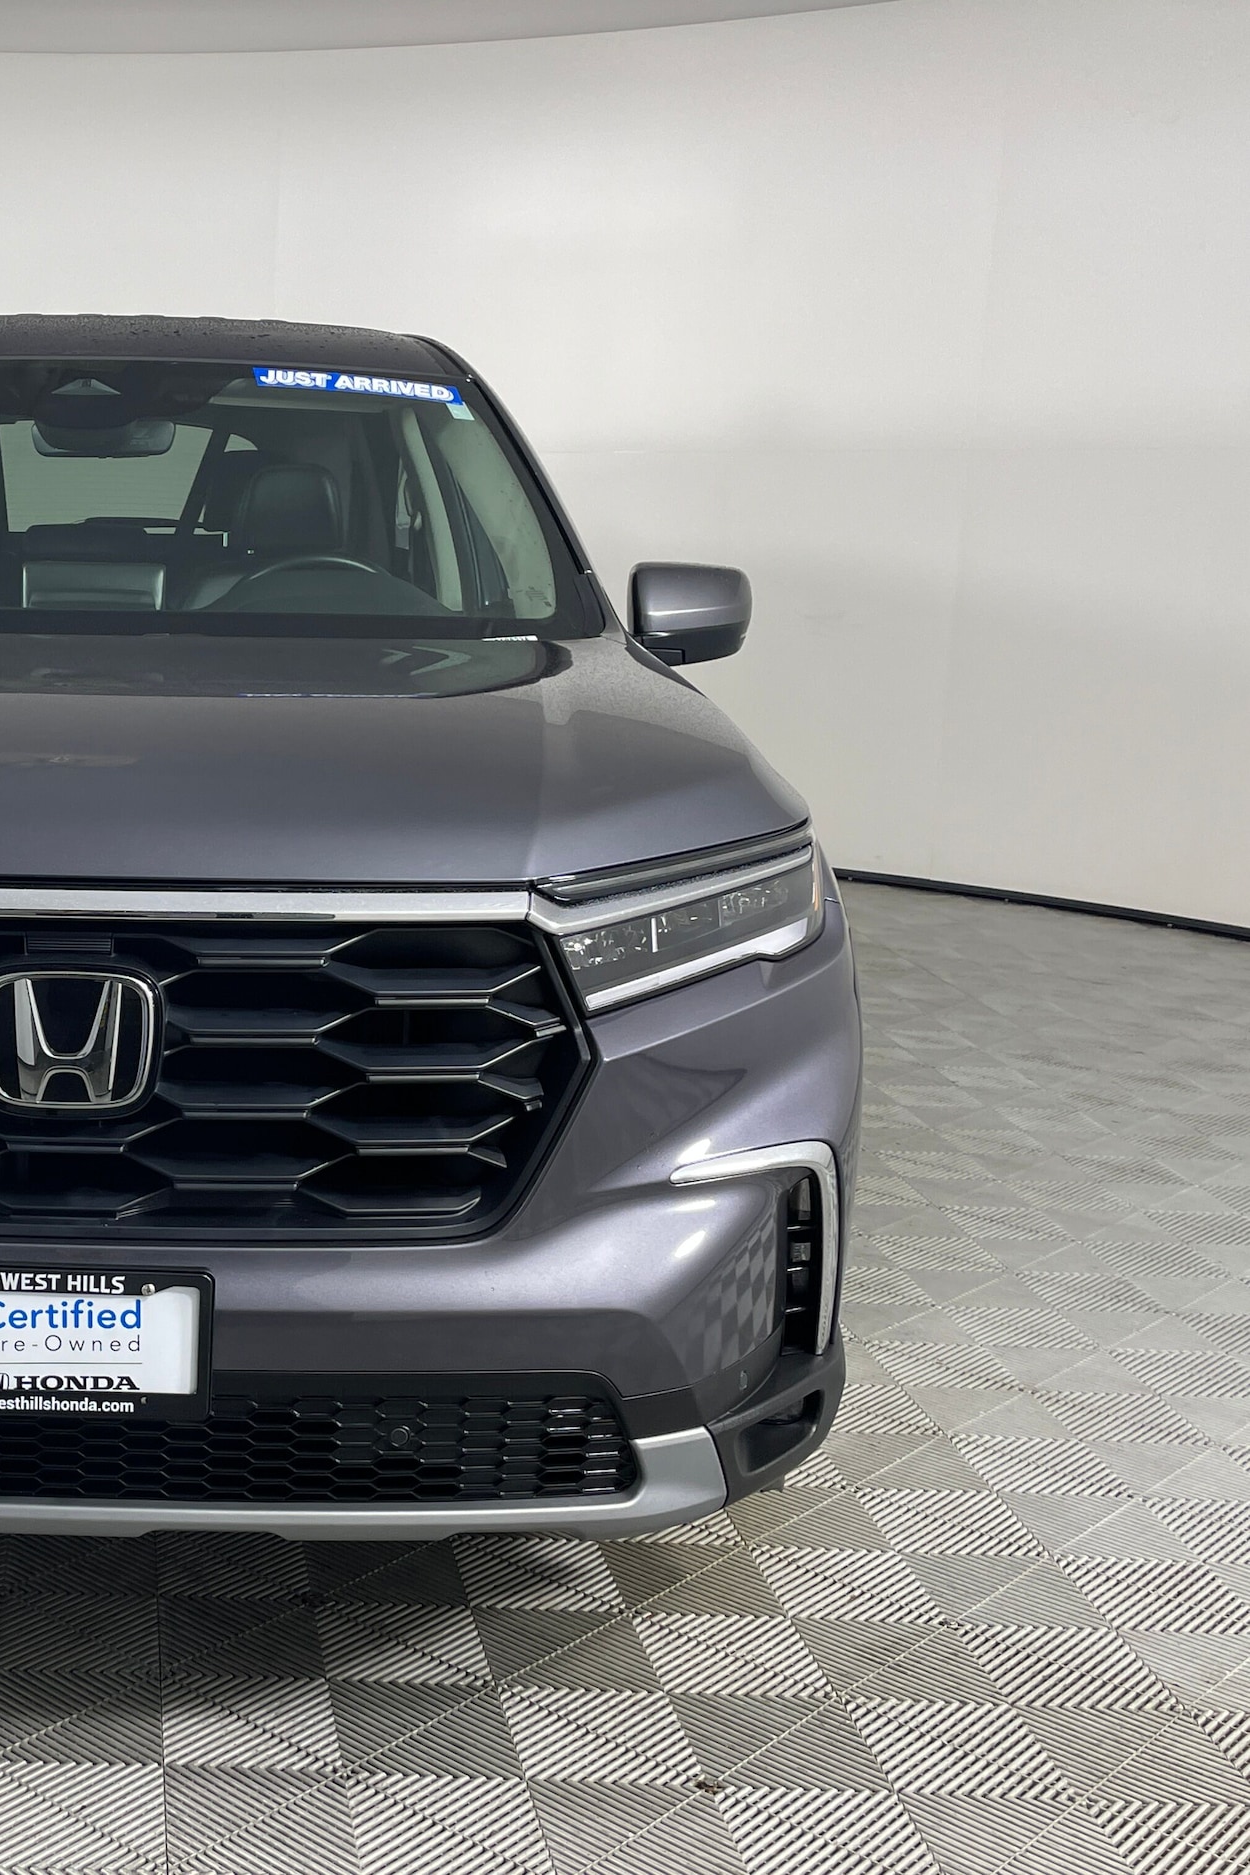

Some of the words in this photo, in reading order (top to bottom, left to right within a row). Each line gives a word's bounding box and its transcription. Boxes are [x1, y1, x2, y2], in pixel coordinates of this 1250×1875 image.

[259, 369, 331, 388] JUST
[334, 375, 454, 401] ARRIVED
[0, 1271, 61, 1291] WEST
[67, 1275, 126, 1294] HILLS
[13, 1375, 140, 1391] HONDA
